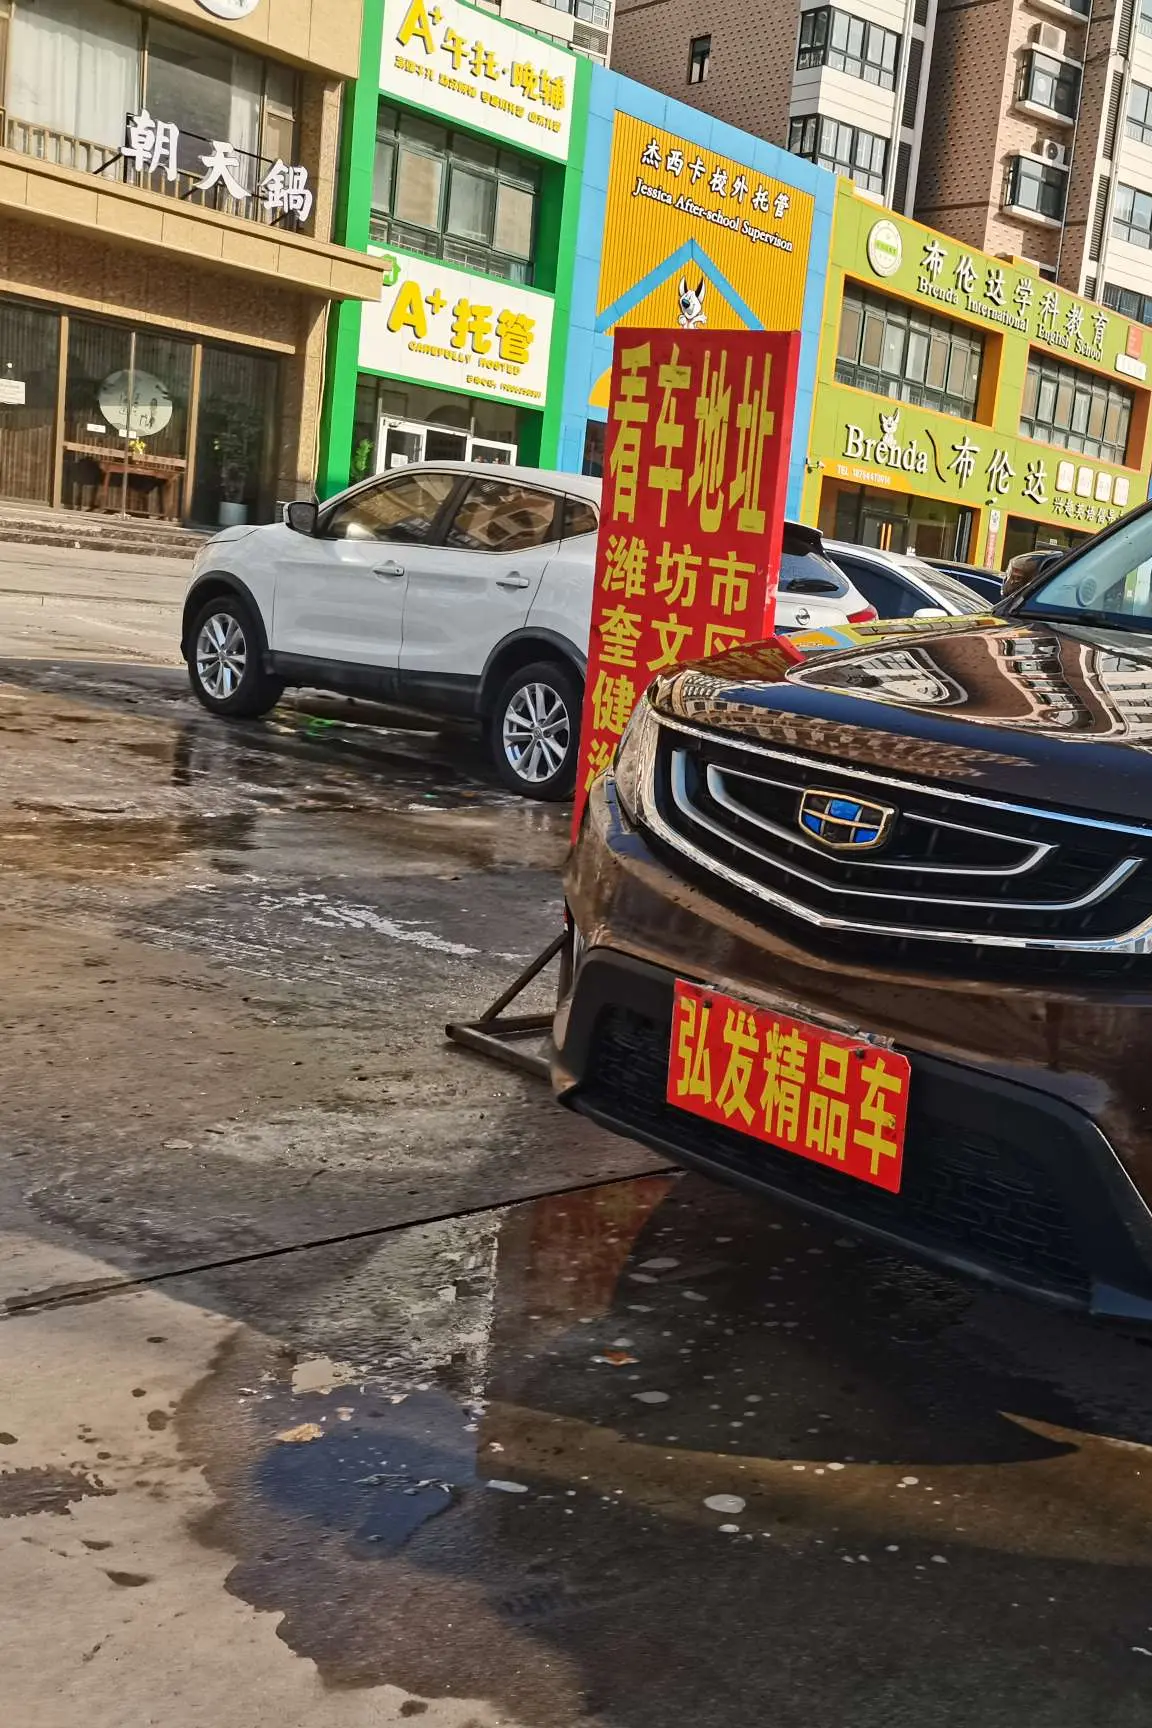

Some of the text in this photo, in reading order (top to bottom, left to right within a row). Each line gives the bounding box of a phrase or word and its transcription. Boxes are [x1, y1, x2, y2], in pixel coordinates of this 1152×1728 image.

[120, 108, 313, 222] 朝天鍋
[632, 177, 673, 206] Jessica
[675, 195, 741, 231] After-school
[641, 139, 790, 218] 杰西卡校外托管
[917, 275, 959, 305] Brenda
[965, 295, 1029, 333] International
[1035, 322, 1071, 349] English
[1074, 340, 1104, 361] School
[920, 240, 1110, 350] 布伦达学科教育
[609, 341, 775, 535] 看车地址
[842, 423, 928, 474] Brenda
[947, 435, 1050, 504] 布伦达
[1052, 496, 1124, 525] 兴趣英语倡导
[601, 534, 756, 615] 潍坊市
[676, 996, 902, 1176] 弘发精品车
